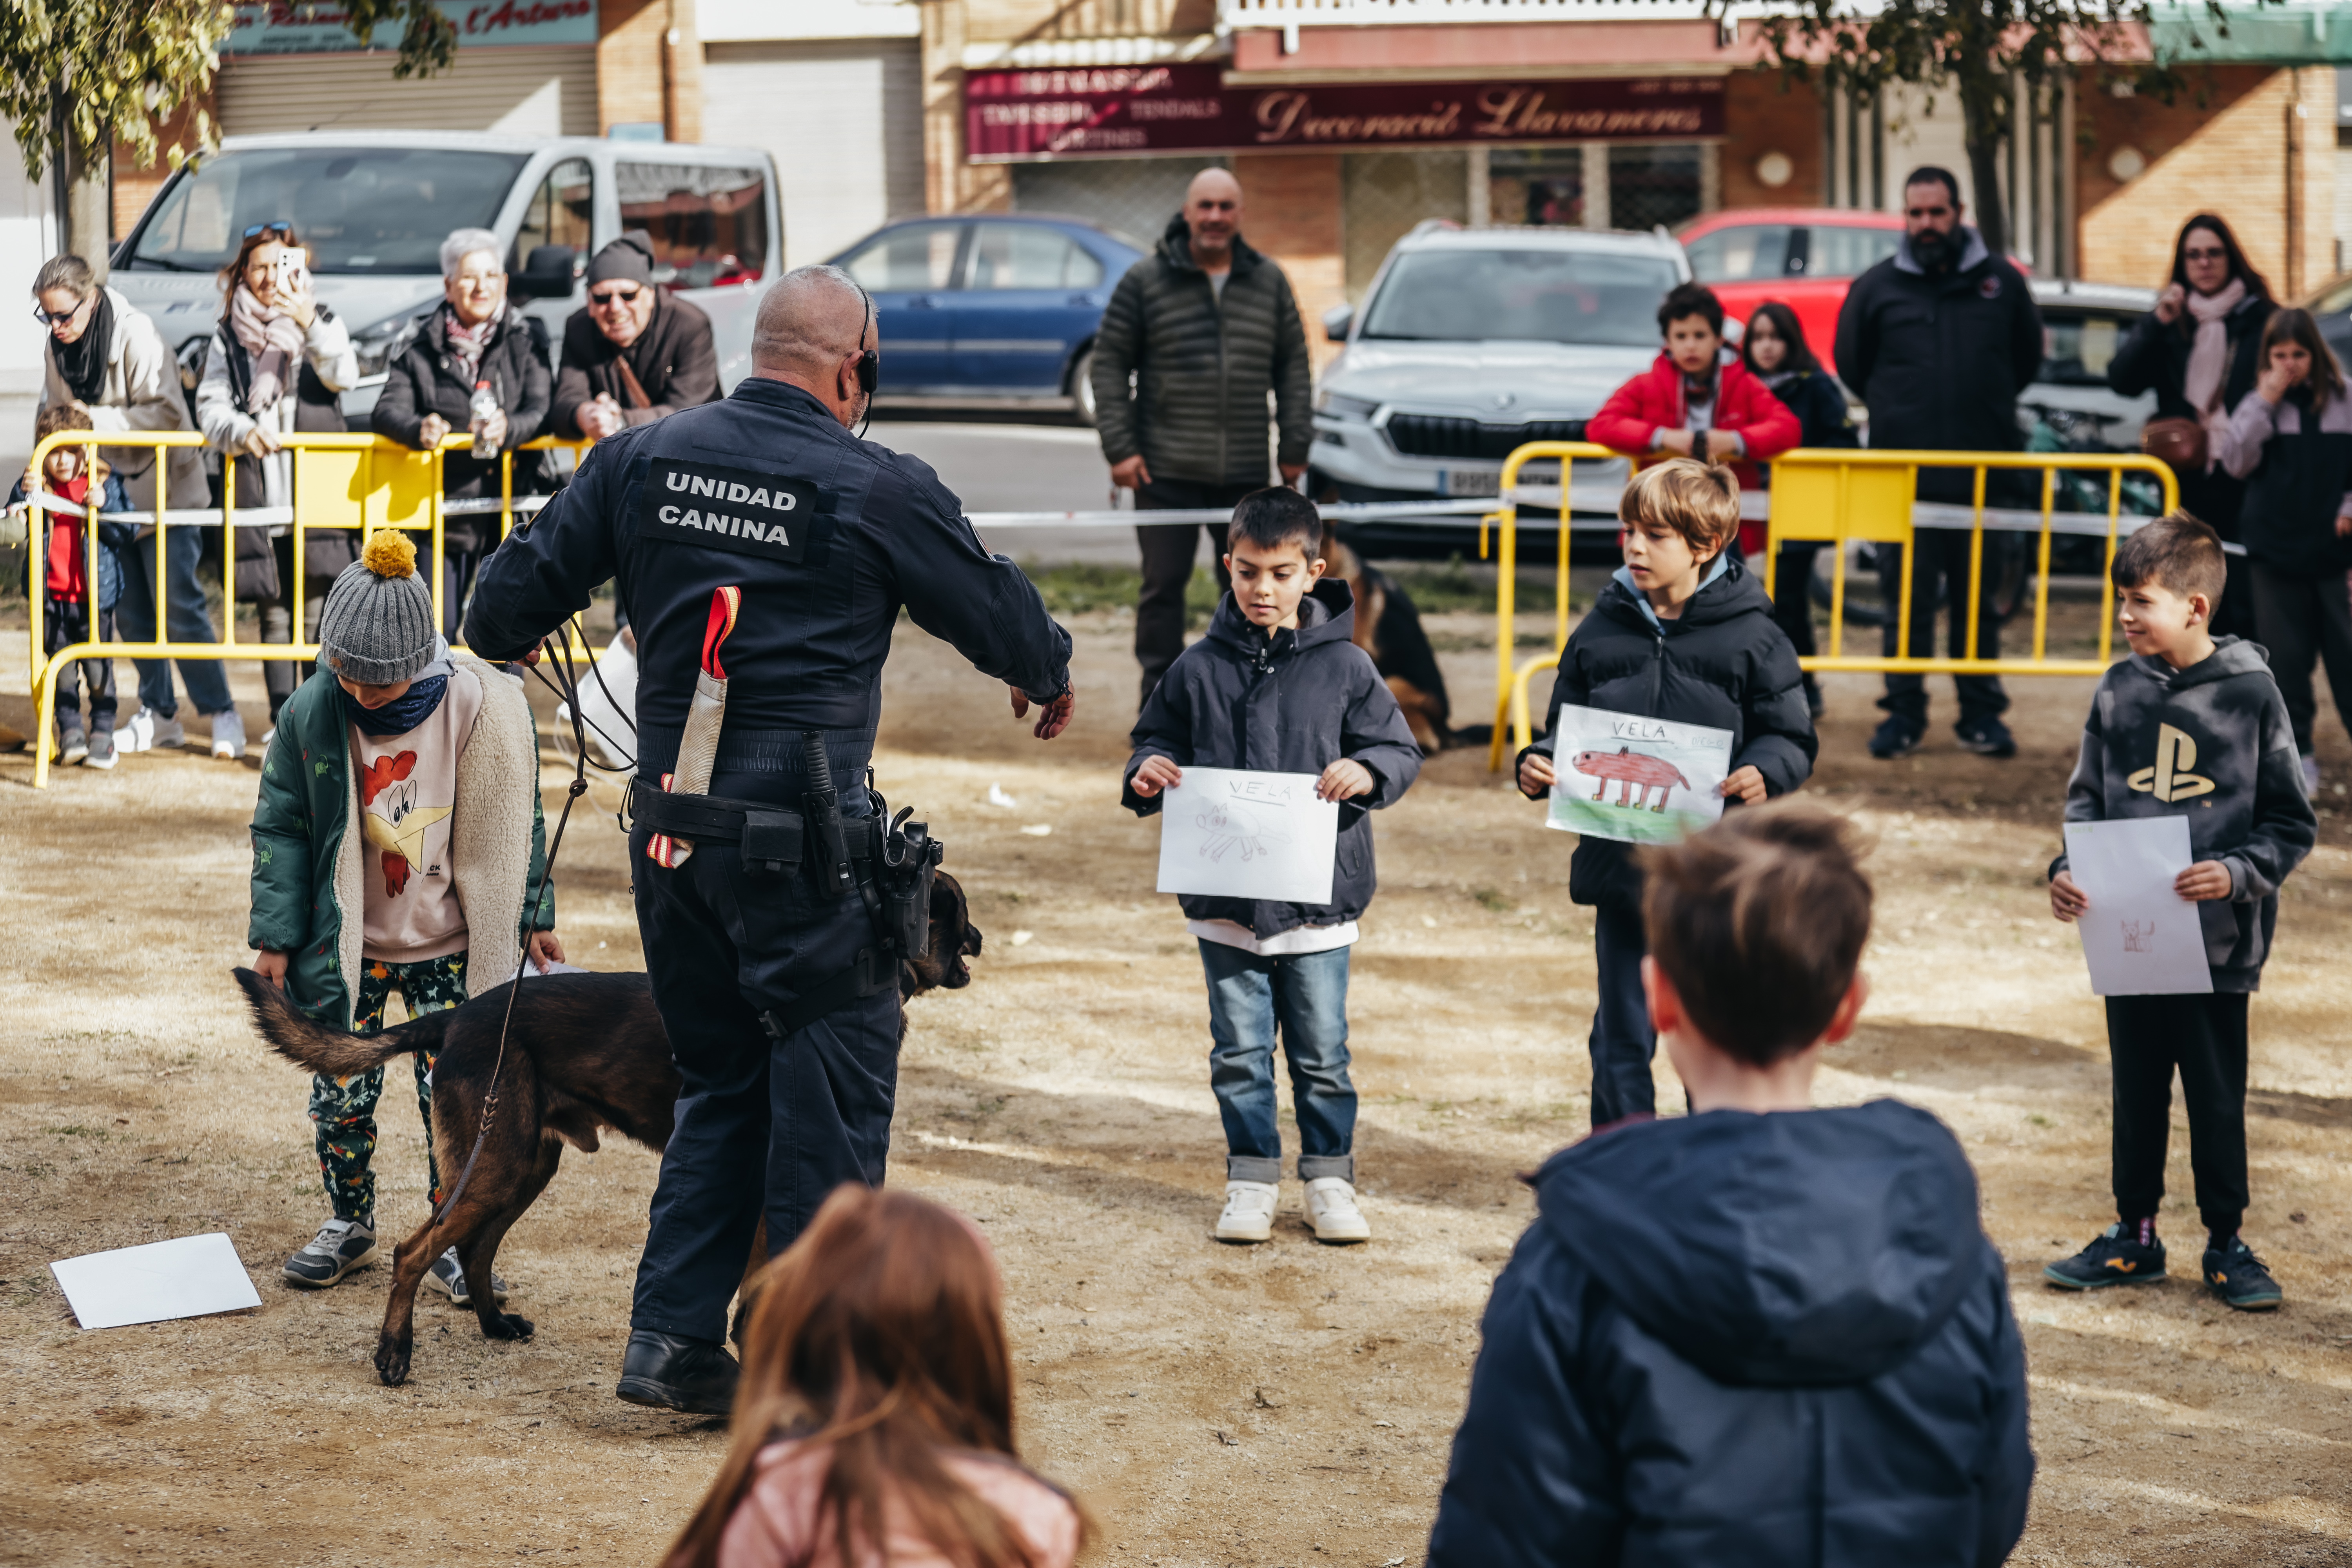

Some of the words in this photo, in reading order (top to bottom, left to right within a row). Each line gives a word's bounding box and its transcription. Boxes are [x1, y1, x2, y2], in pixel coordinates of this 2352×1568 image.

[666, 472, 797, 511] UNIDAD
[659, 505, 789, 546] CANINA
[1613, 721, 1665, 738] VELA
[1230, 780, 1291, 800] VELA
